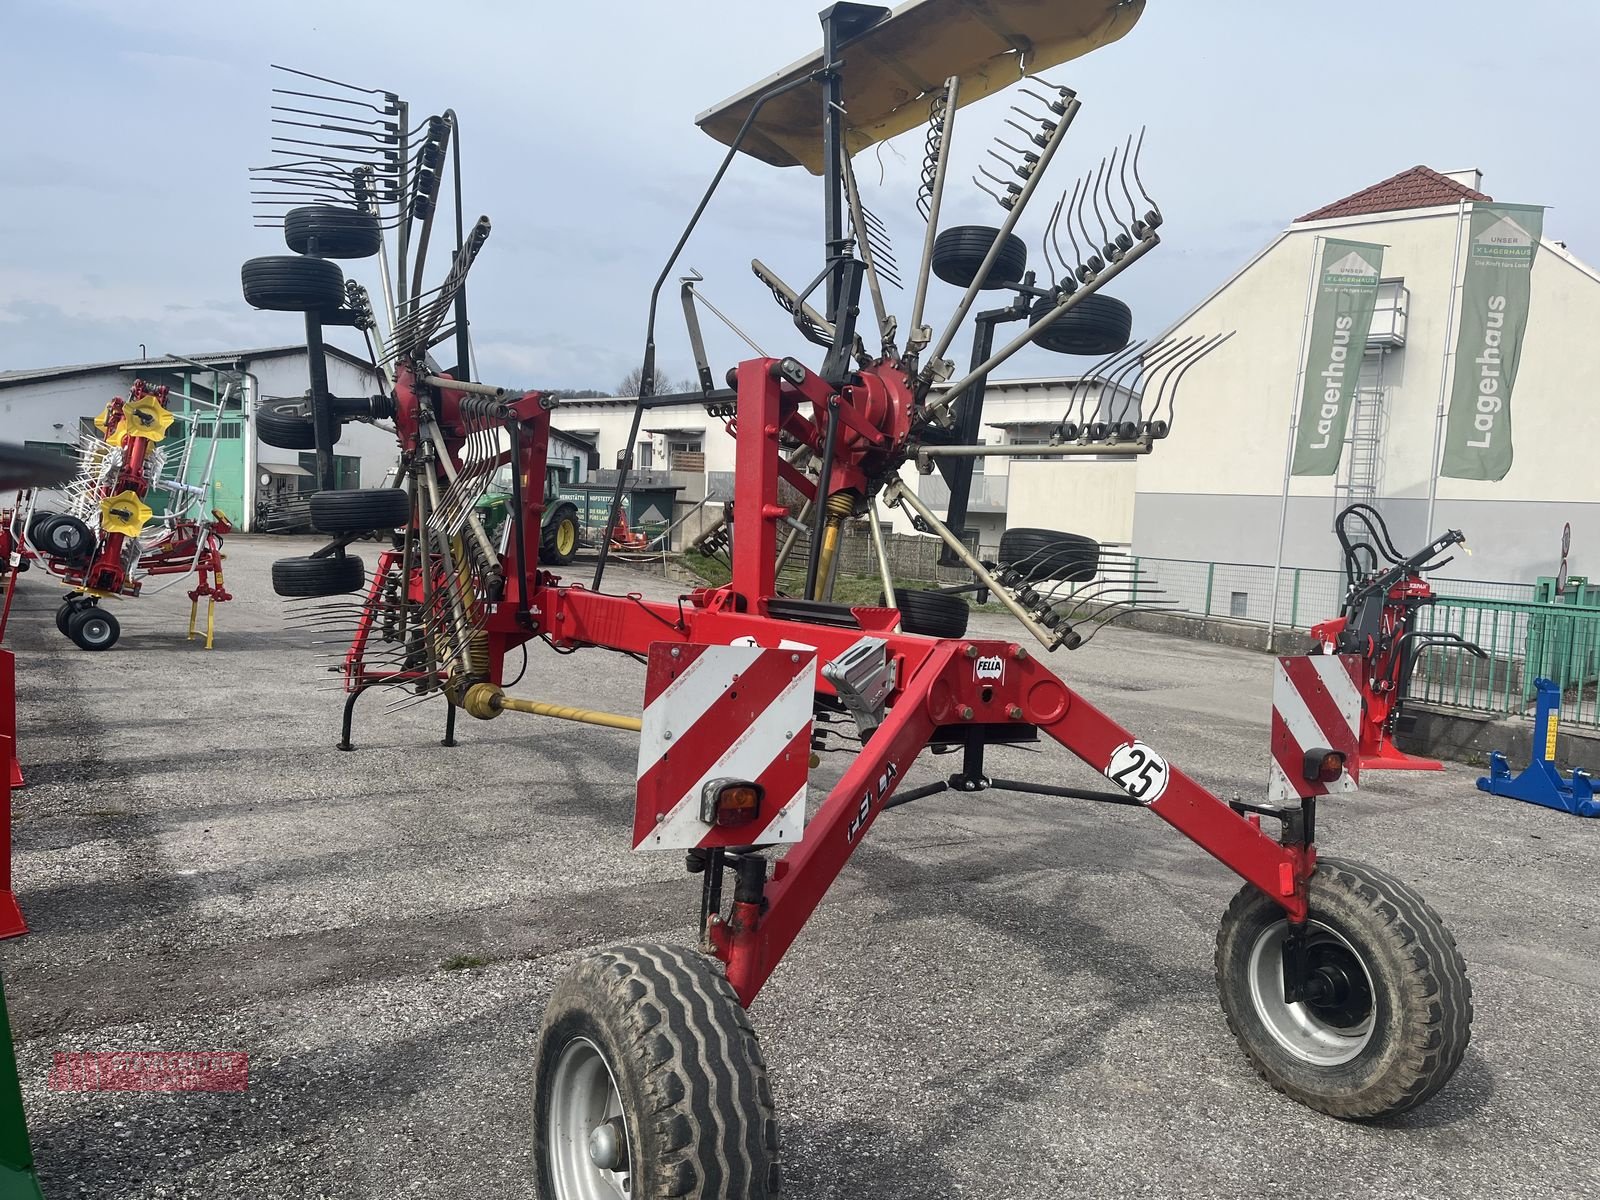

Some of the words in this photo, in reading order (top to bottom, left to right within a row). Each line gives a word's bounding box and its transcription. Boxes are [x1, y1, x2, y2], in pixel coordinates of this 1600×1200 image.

[1490, 236, 1519, 244] UNSER
[1484, 247, 1531, 256] LAGERHAUS
[1333, 276, 1375, 284] LAGERHAUS
[1467, 294, 1506, 449] Lagerhaus
[1310, 315, 1353, 450] Lagerhaus
[977, 661, 1001, 671] FELLA
[1111, 749, 1163, 798] 25
